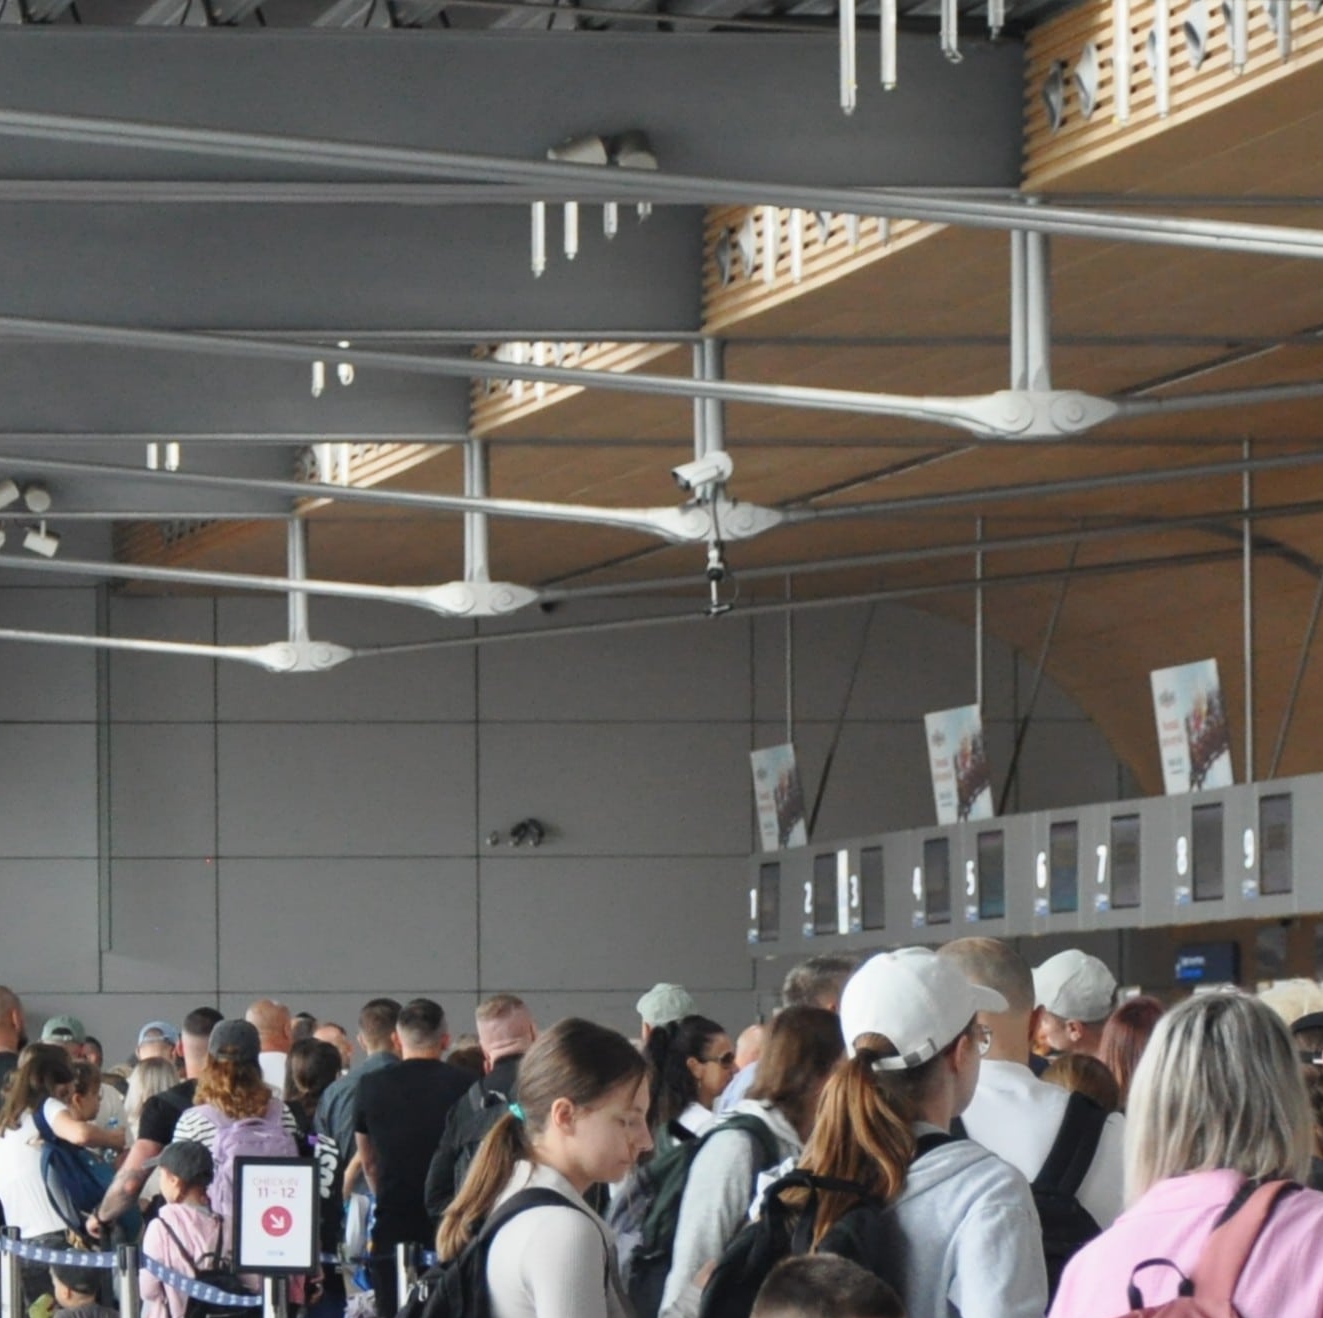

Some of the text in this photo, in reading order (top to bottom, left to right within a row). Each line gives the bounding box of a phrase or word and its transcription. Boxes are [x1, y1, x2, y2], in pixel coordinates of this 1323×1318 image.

[1095, 844, 1108, 884] 7
[1176, 835, 1188, 876] 8
[1243, 827, 1255, 869] 9
[912, 865, 923, 901] 4
[965, 858, 977, 896] 5
[1036, 850, 1048, 890] 6
[749, 887, 758, 920] 1
[803, 880, 813, 915] 2
[849, 873, 860, 909] 3
[258, 1187, 269, 1199] 11
[281, 1187, 295, 1199] 12
